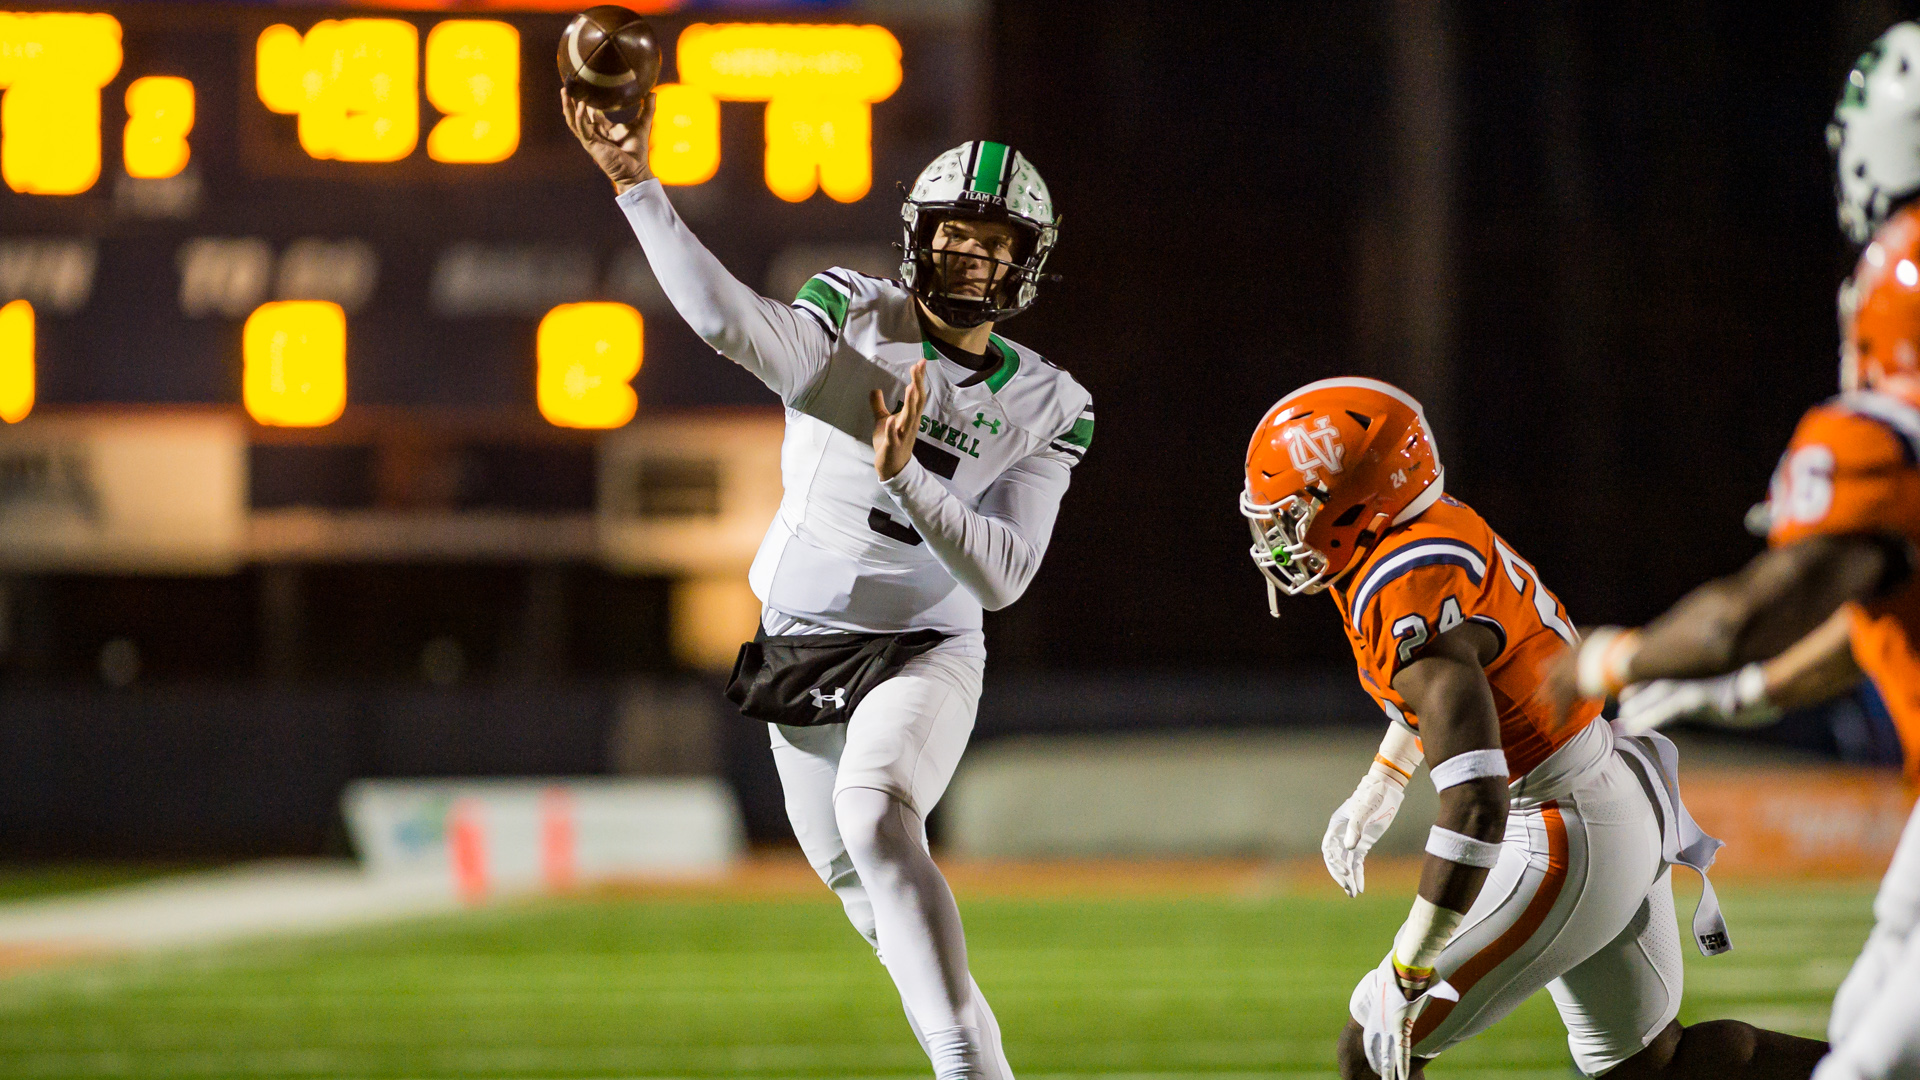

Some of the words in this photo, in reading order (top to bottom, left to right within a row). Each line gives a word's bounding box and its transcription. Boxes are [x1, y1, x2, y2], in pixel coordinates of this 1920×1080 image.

[964, 191, 990, 203] TEAM
[991, 195, 1002, 206] 72
[891, 401, 980, 459] SWELL
[1390, 468, 1407, 489] 24
[1493, 533, 1583, 648] 2
[1391, 594, 1467, 664] 24
